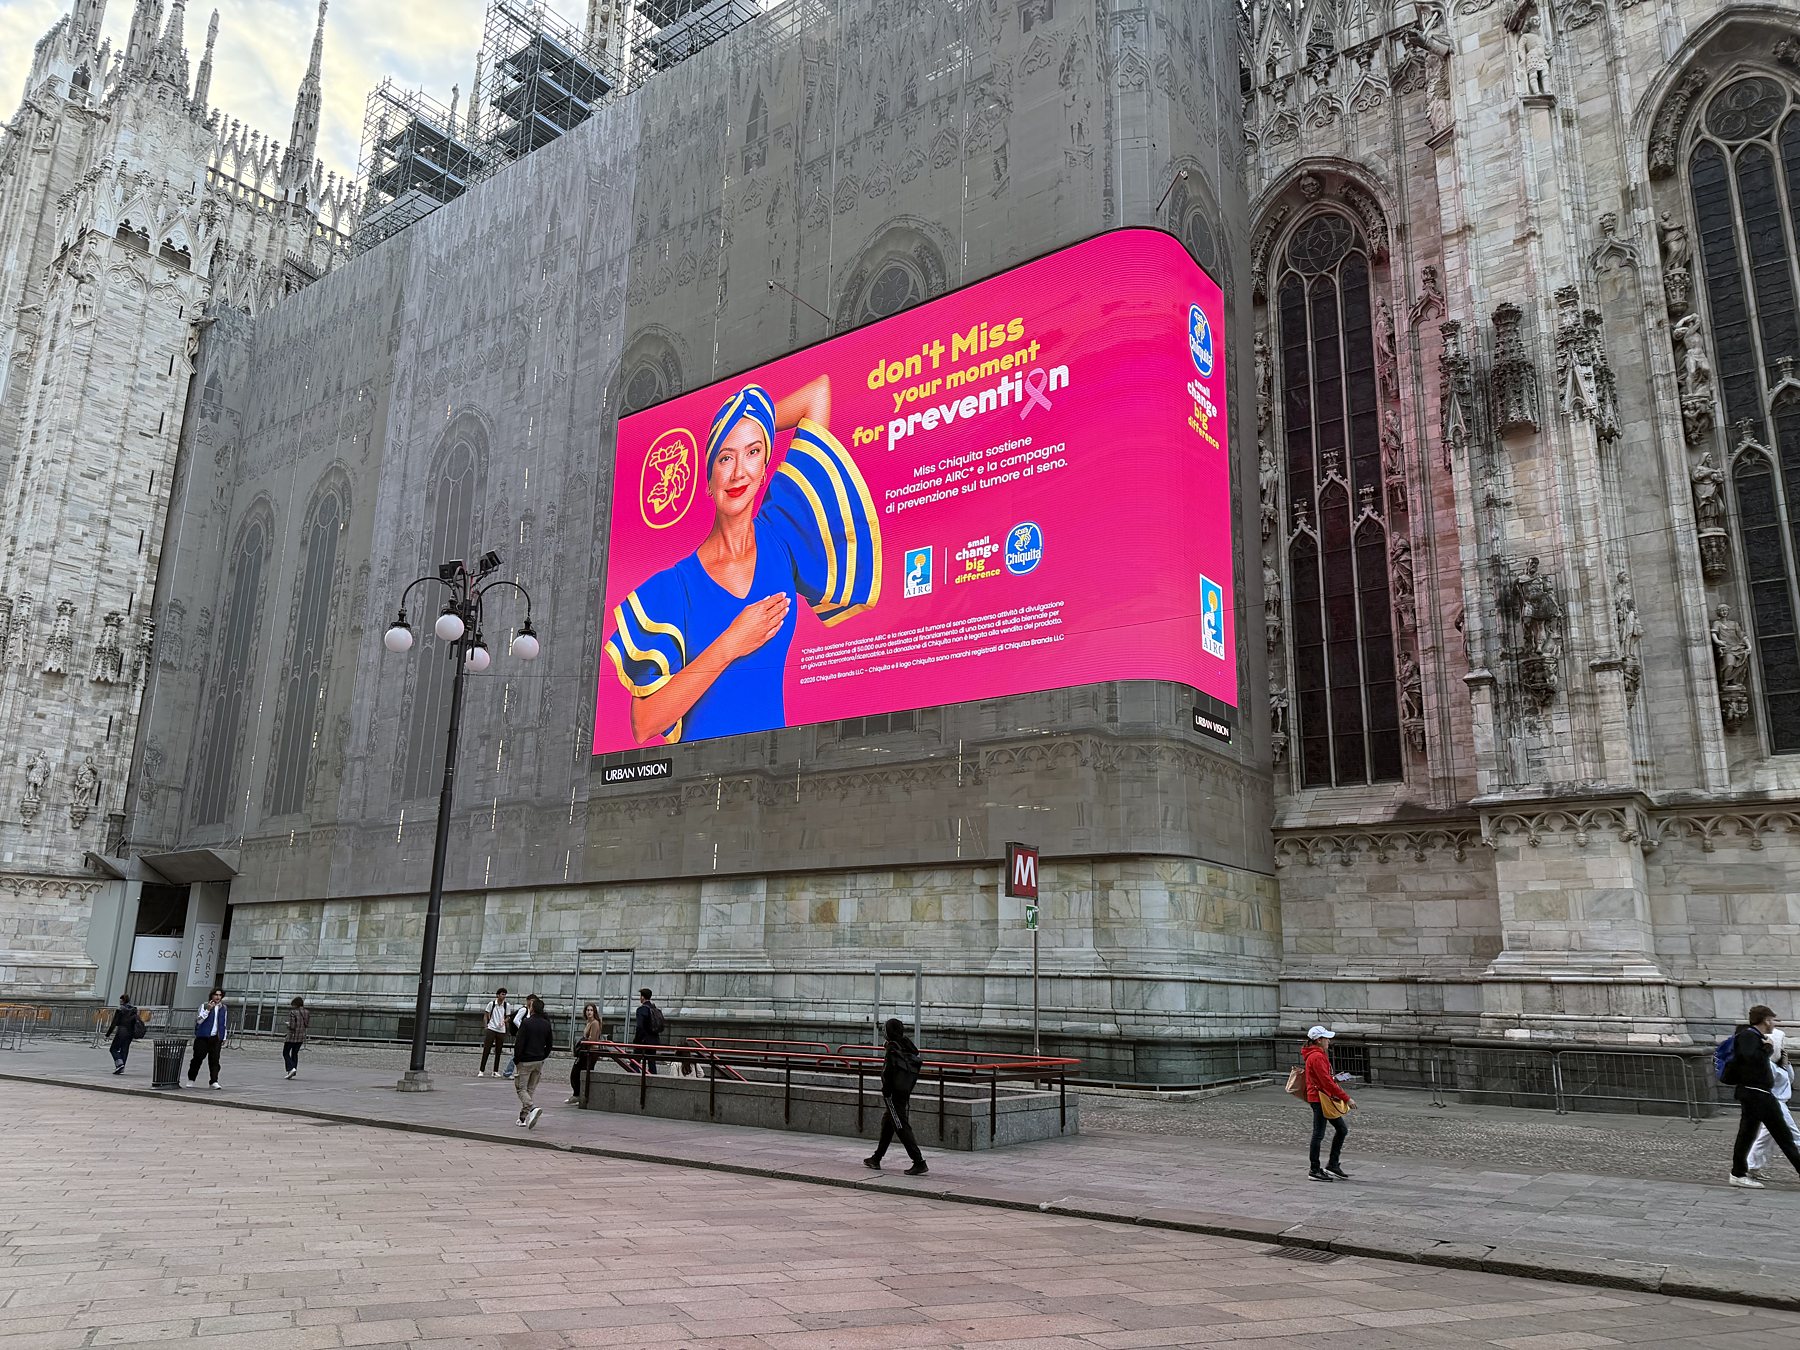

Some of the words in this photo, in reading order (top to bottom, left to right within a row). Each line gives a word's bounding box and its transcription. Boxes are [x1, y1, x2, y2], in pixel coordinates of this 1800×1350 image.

[867, 339, 945, 390] don't
[951, 317, 1025, 363] Miss
[1189, 333, 1213, 368] Chiquita
[892, 377, 942, 413] your
[946, 339, 1041, 390] moment
[1194, 379, 1211, 399] small
[1187, 381, 1218, 418] change
[1193, 401, 1209, 431] big
[852, 424, 885, 447] for
[1187, 416, 1220, 450] difference
[885, 478, 943, 500] Fondazione
[977, 466, 985, 475] e
[987, 460, 998, 472] la
[1000, 442, 1066, 468] campagna
[913, 465, 936, 478] Miss
[938, 450, 983, 470] Chiquita
[985, 436, 1033, 457] sostiene
[885, 501, 895, 514] di
[897, 486, 959, 514] prevenzione
[961, 480, 977, 494] sul
[979, 468, 1021, 489] tumore
[1022, 466, 1034, 477] al
[1037, 457, 1068, 474] seno.
[955, 542, 1000, 561] change
[967, 535, 990, 548] small
[1005, 547, 1042, 566] Chiquita
[954, 568, 1001, 584] difference
[965, 558, 986, 572] big
[905, 584, 931, 597] AIRC
[815, 652, 825, 660] una
[825, 649, 850, 658] donazione
[875, 641, 887, 649] euro
[888, 638, 912, 647] destinata
[919, 629, 958, 641] finanziamento
[977, 621, 994, 630] borsa
[1002, 616, 1021, 626] studio
[1021, 611, 1048, 622] biennale
[1048, 609, 1060, 619] per
[845, 637, 874, 647] Fondazione
[891, 630, 897, 638] la
[916, 626, 924, 634] sul
[925, 623, 945, 632] tumore
[952, 619, 966, 627] seno
[967, 614, 996, 624] attraverso
[997, 608, 1018, 617] attività
[1025, 600, 1064, 612] divulgazione
[808, 659, 827, 670] giovane
[886, 647, 893, 655] La
[894, 643, 921, 653] donazione
[927, 637, 951, 647] Chiquita
[951, 635, 963, 643] non
[968, 630, 988, 641] legata
[988, 628, 1000, 636] alla
[1000, 624, 1023, 634] vendita
[1023, 622, 1034, 630] del
[1034, 618, 1063, 629] prodotto.
[816, 672, 836, 682] Chiquita
[837, 670, 855, 678] Brands
[855, 667, 865, 676] LLC
[868, 663, 891, 673] Chiquita
[899, 659, 911, 669] logo
[912, 655, 936, 665] Chiquita
[936, 653, 950, 662] sono
[950, 649, 971, 659] marchi
[972, 644, 997, 656] registrati
[997, 643, 1004, 651] di
[1004, 638, 1031, 650] Chiquita
[1031, 635, 1053, 646] Brands
[1053, 632, 1065, 642] LLC
[1203, 637, 1224, 657] AIRC
[1195, 714, 1213, 731] URBAN
[1213, 719, 1230, 737] VISION
[605, 767, 635, 781] URBAN
[637, 763, 668, 776] VISION
[1014, 854, 1036, 887] M
[194, 934, 205, 974] SCALE
[204, 930, 216, 979] STAIRS
